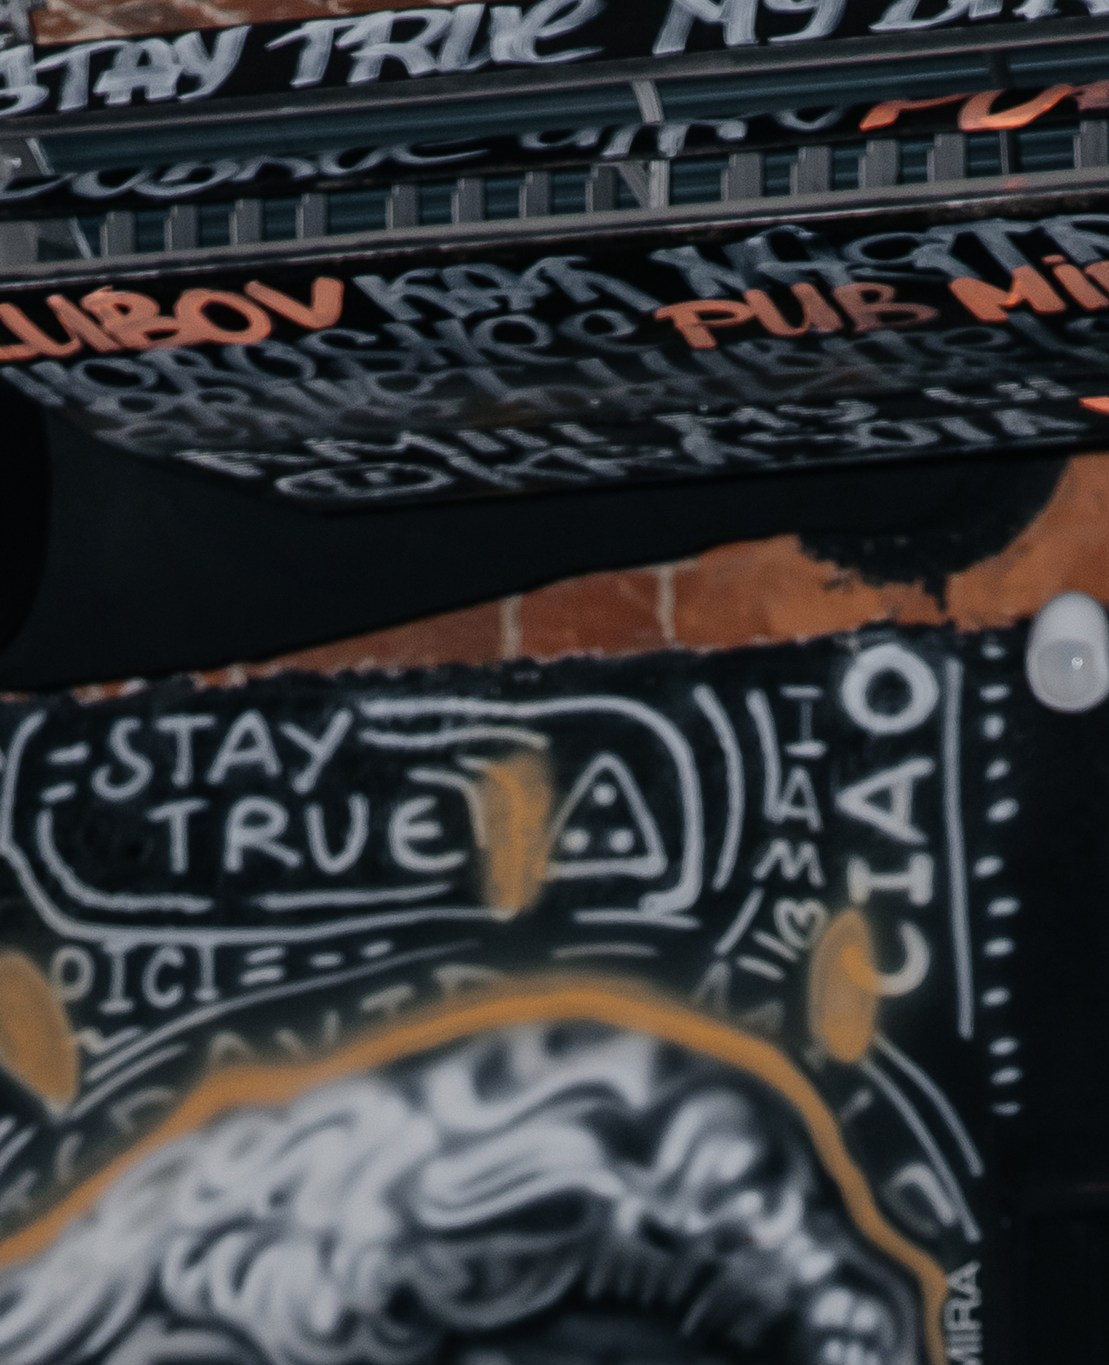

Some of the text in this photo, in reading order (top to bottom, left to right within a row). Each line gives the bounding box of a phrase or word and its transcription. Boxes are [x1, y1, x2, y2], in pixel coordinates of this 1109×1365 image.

[265, 0, 605, 87] TRUE
[0, 277, 345, 363] UBOV
[656, 281, 939, 349] PUB
[92, 709, 354, 800] STAY
[146, 795, 467, 874] TRUE
[838, 643, 939, 996] CIAO
